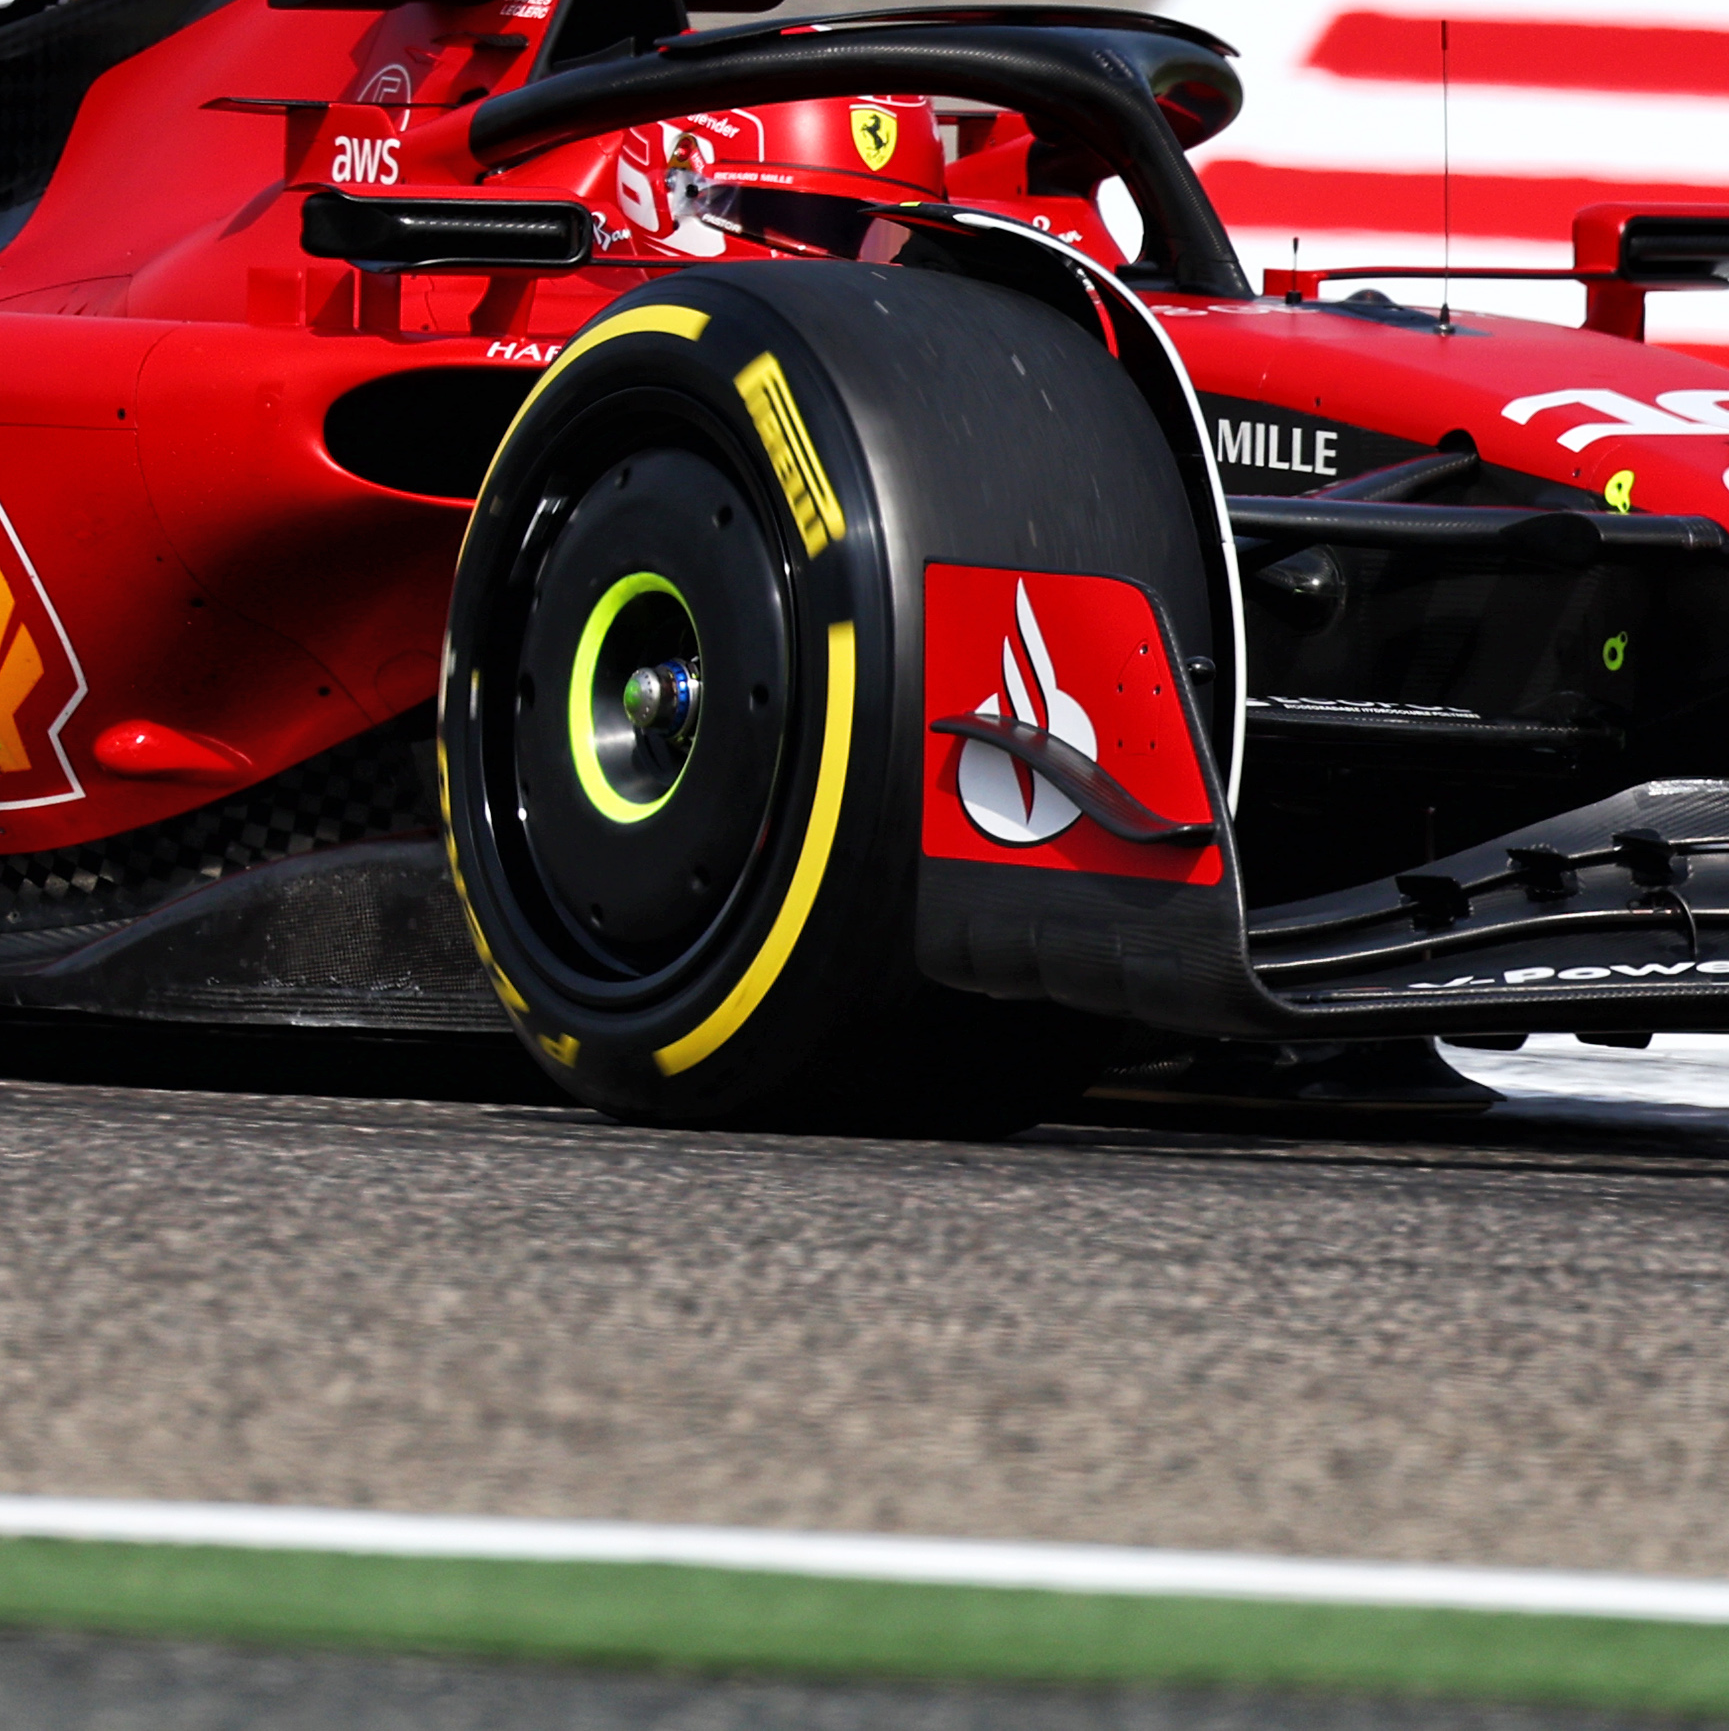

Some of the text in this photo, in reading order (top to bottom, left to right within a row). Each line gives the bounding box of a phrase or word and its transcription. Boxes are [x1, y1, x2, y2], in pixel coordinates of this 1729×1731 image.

[499, 4, 551, 20] LECLERC
[332, 135, 401, 186] aws
[713, 171, 794, 184] RICHARD MILLE
[1217, 418, 1339, 477] MILLE
